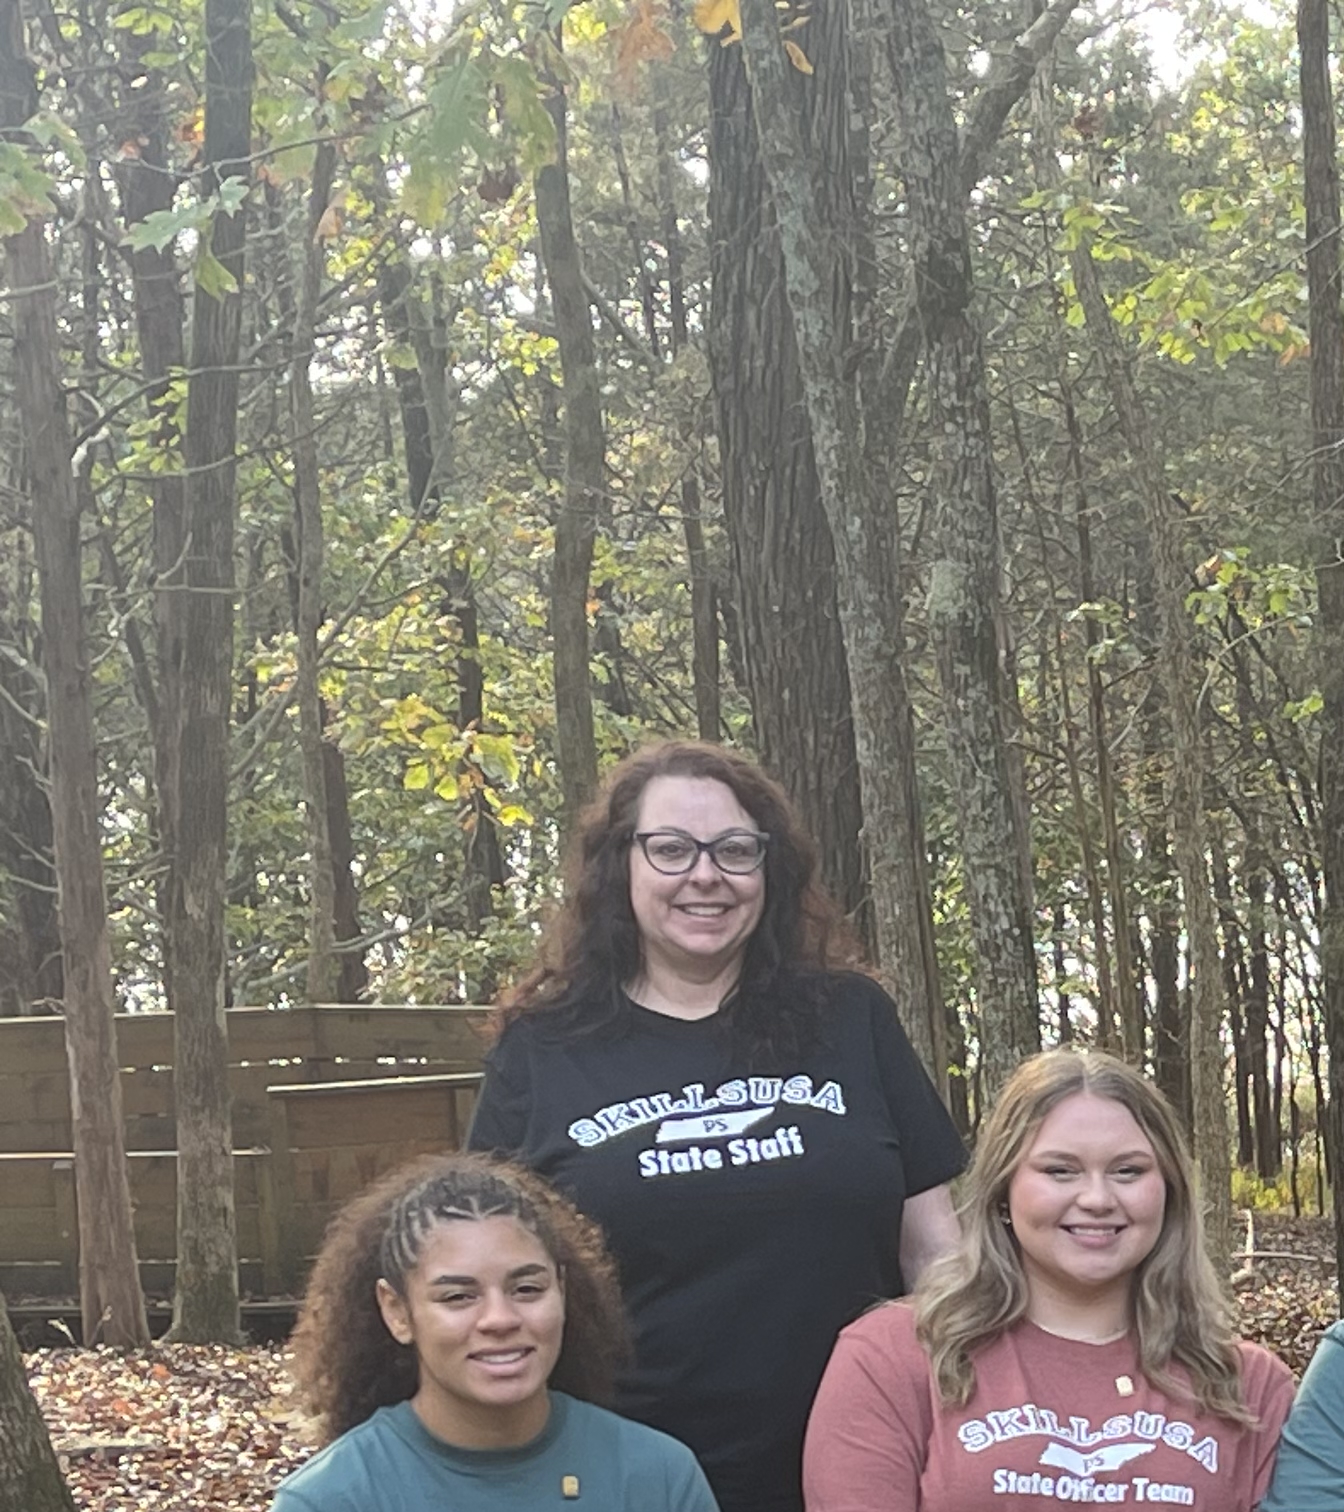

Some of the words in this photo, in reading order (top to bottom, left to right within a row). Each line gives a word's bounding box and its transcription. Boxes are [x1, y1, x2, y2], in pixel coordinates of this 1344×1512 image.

[568, 1075, 846, 1147] SKILLSUSA
[703, 1119, 727, 1132] PS
[639, 1147, 722, 1177] State
[728, 1126, 804, 1165] Staff
[958, 1404, 1218, 1473] SKILLSUSA
[994, 1470, 1054, 1495] State
[1056, 1476, 1129, 1502] Officer
[1132, 1478, 1194, 1505] Team
